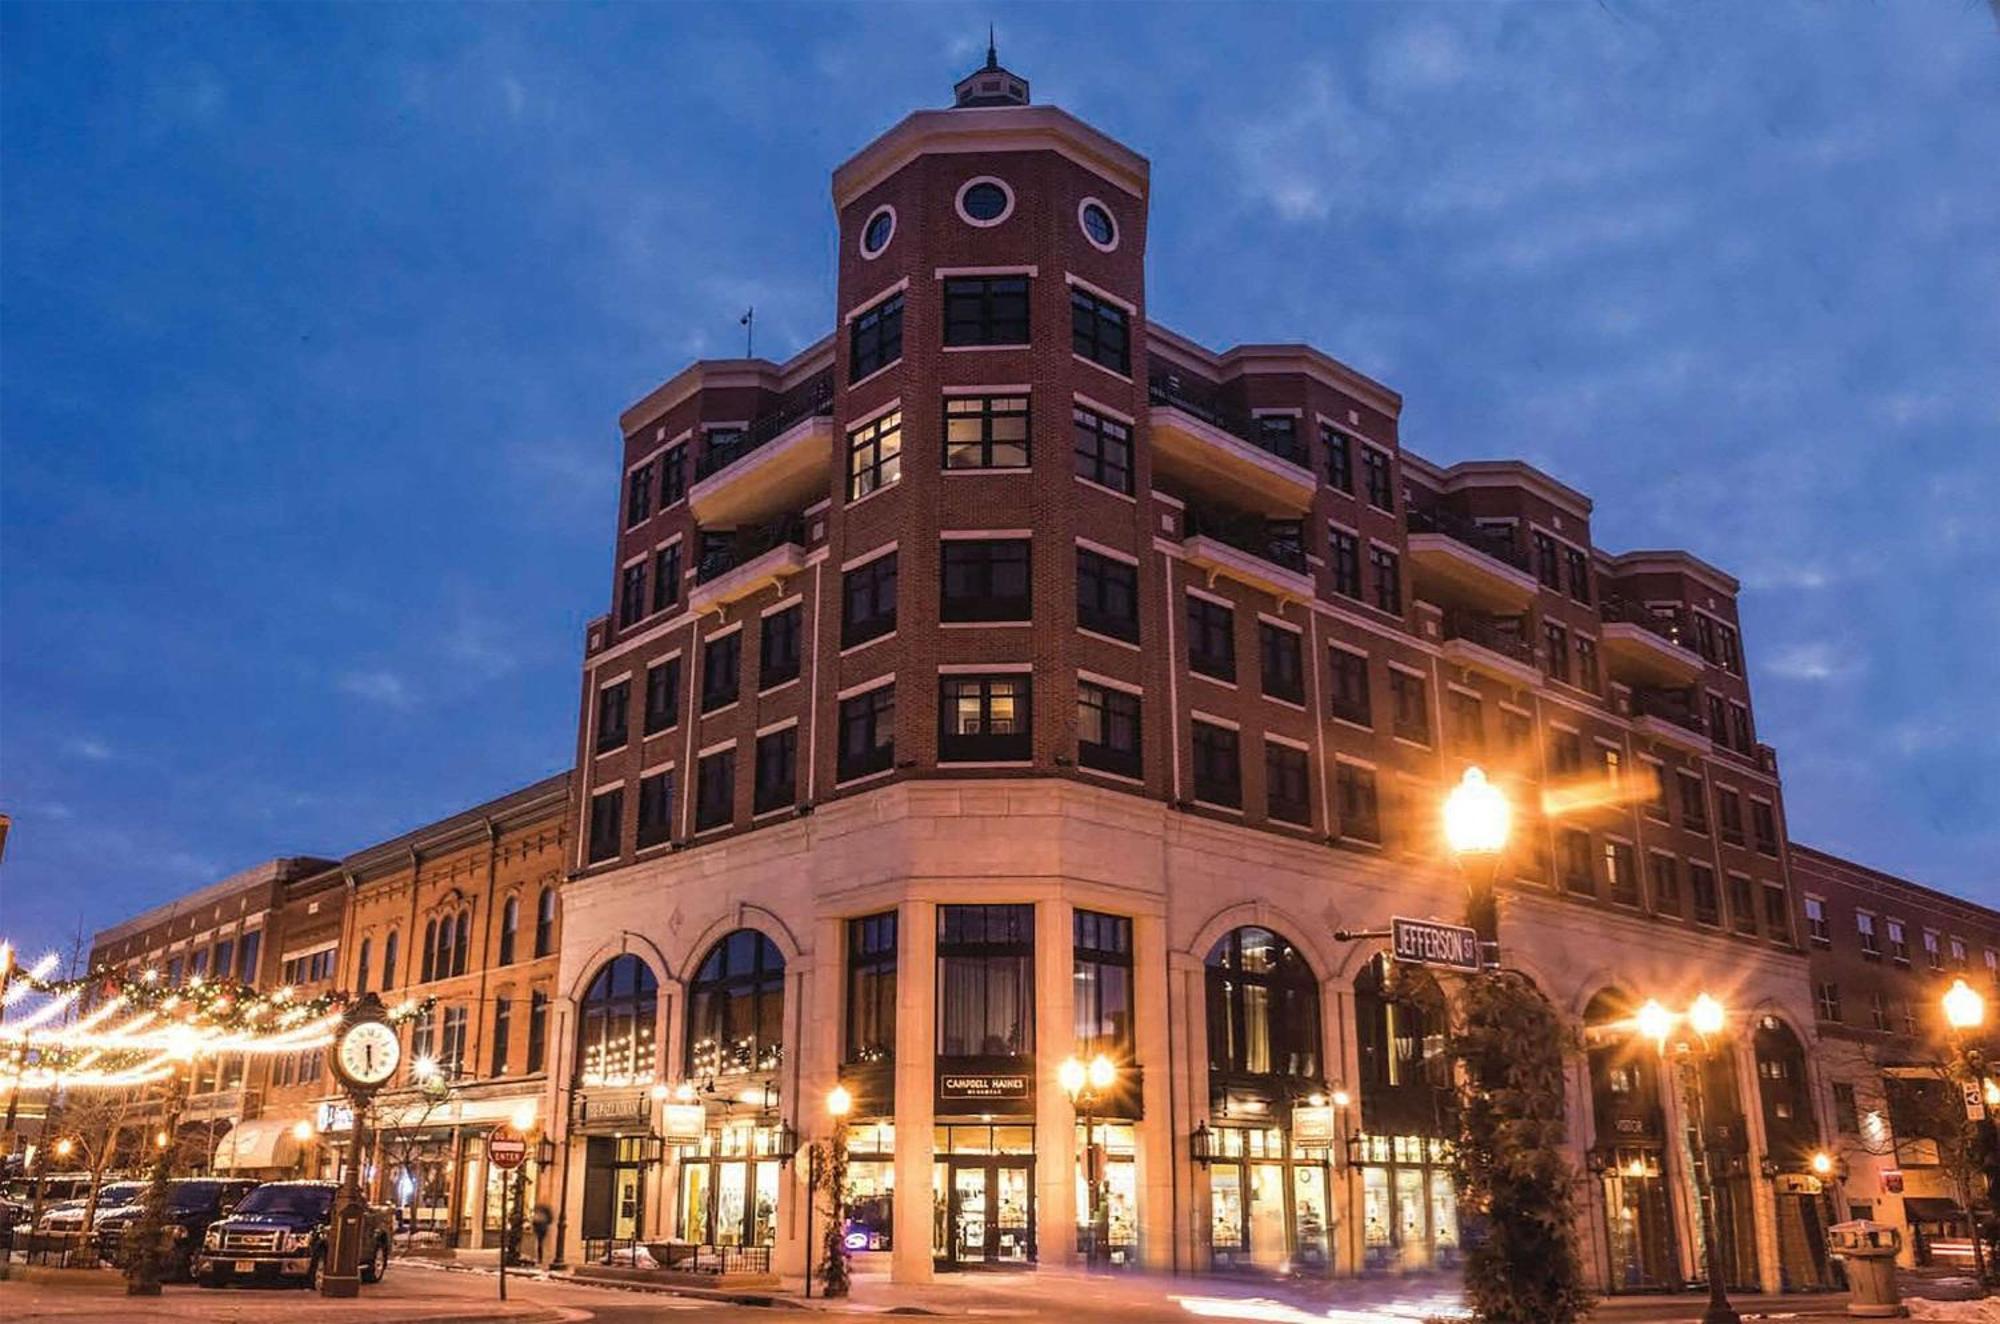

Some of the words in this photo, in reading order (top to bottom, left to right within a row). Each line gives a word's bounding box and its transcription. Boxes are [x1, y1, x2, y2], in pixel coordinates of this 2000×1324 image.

[1397, 923, 1463, 962] JEFFERSON
[1463, 938, 1474, 959] ST
[495, 1151, 520, 1161] ENTER
